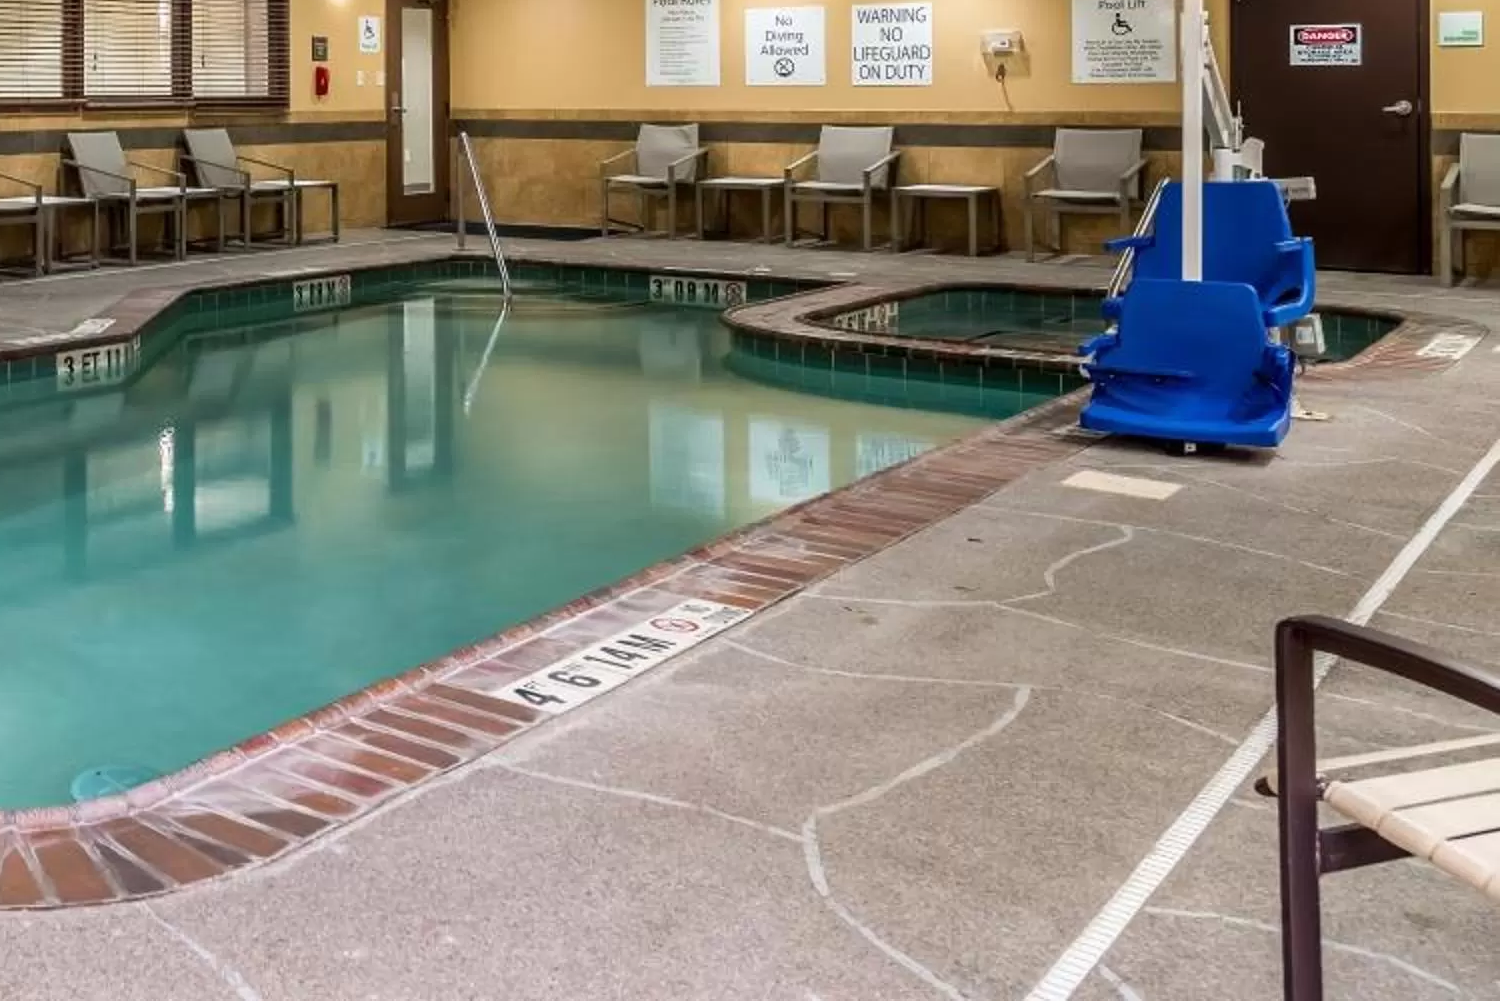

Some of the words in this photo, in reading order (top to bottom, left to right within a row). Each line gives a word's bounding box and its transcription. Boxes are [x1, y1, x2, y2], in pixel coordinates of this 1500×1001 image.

[1098, 0, 1124, 9] Pool
[775, 14, 792, 27] No
[857, 6, 927, 24] WARNING
[765, 30, 804, 43] Diving
[880, 26, 903, 42] NO
[1302, 31, 1347, 40] DANGER
[759, 43, 809, 56] Allowed
[853, 44, 931, 62] LIFEGUARD
[859, 64, 881, 80] ON
[885, 64, 927, 80] DUTY
